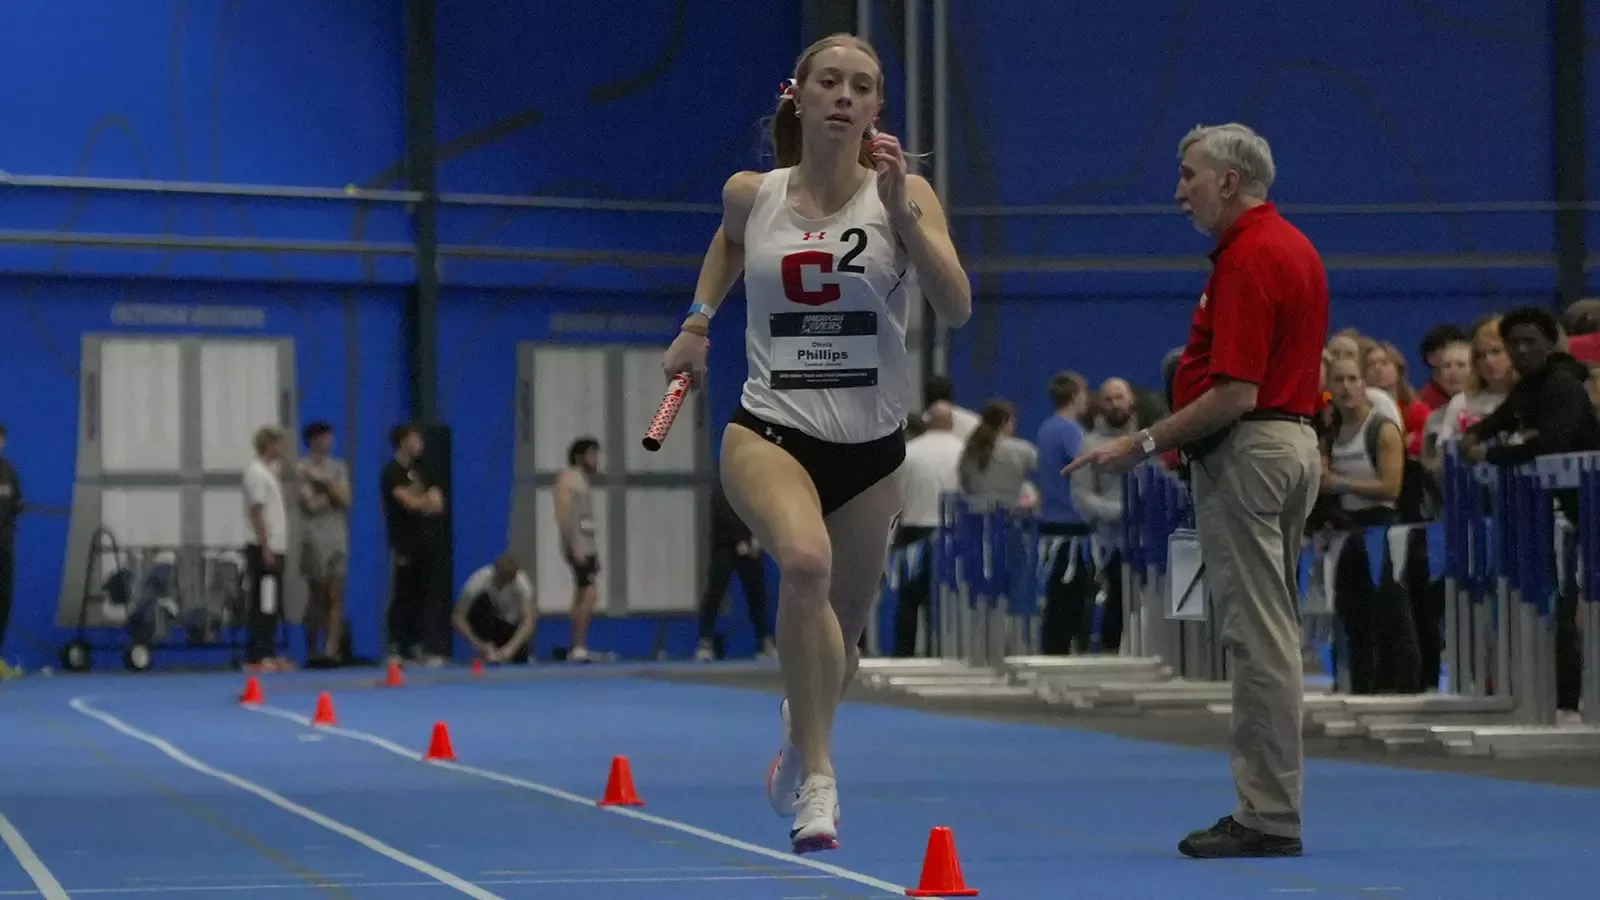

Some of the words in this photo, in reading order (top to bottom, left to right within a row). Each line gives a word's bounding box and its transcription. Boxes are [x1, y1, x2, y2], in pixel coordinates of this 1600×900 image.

[837, 227, 868, 274] 2
[781, 250, 841, 307] C
[797, 349, 849, 362] Phillips
